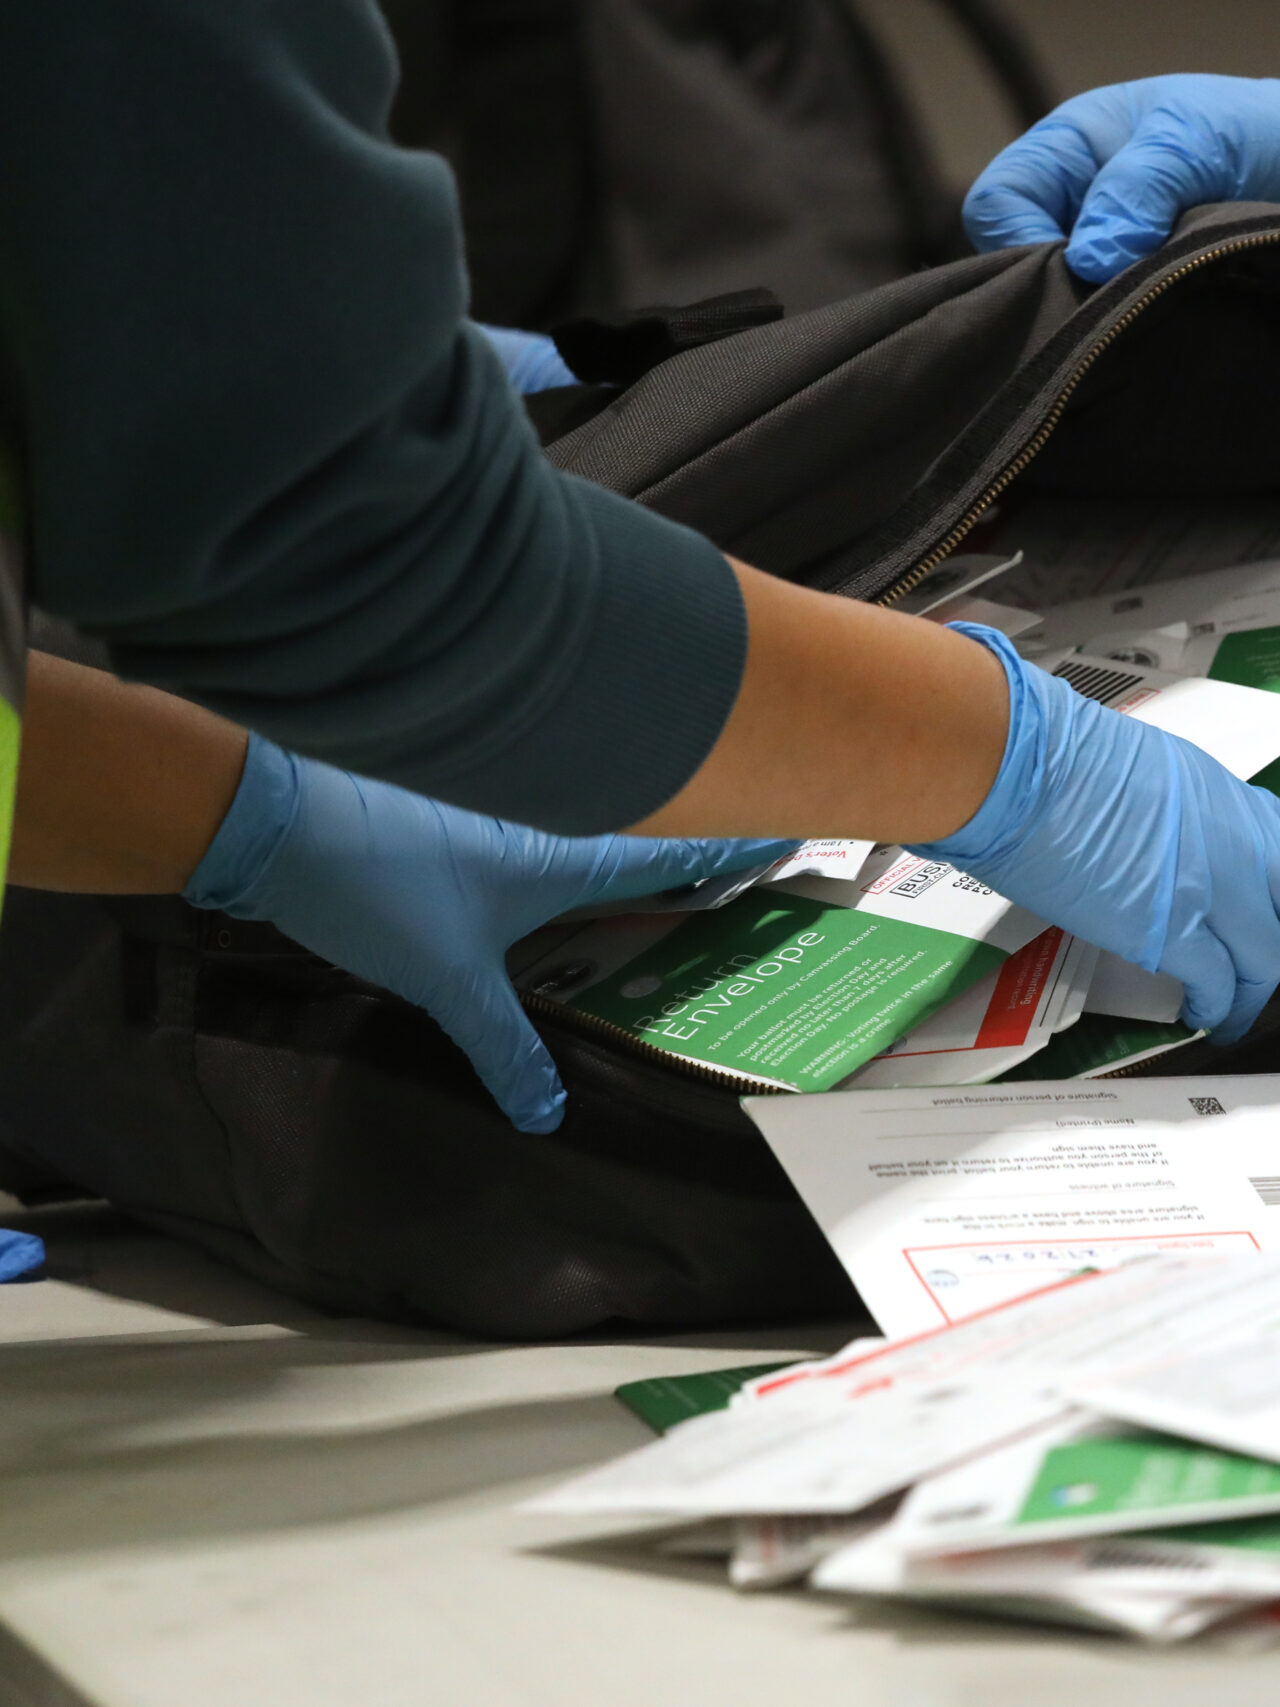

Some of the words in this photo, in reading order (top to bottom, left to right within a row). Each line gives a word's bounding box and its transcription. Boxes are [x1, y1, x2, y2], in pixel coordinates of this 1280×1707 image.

[806, 850, 846, 858] Voter's
[873, 864, 914, 889] OFFICIAL
[898, 862, 947, 892] BUSI
[913, 865, 955, 894] FIRST-CLA
[952, 876, 970, 888] CO
[661, 932, 825, 1040] Envelope
[708, 1041, 721, 1051] To
[719, 1031, 733, 1041] be
[734, 1005, 768, 1030] opened
[768, 990, 789, 1005] only
[787, 982, 801, 991] by
[800, 946, 852, 982] Canvassing
[848, 924, 881, 946] Board.
[632, 954, 758, 1033] Return
[737, 1042, 759, 1058] Your
[758, 1019, 786, 1040] ballot
[787, 1002, 810, 1020] must
[808, 994, 822, 1003] be
[822, 965, 862, 994] returned
[862, 958, 872, 967] or
[750, 1019, 801, 1062] postmarked
[800, 1010, 815, 1019] by
[813, 984, 851, 1010] Election
[850, 970, 870, 984] Day
[868, 958, 887, 971] and
[761, 1032, 798, 1064] received
[798, 1024, 811, 1032] no
[810, 1008, 832, 1023] later
[833, 992, 855, 1007] than
[863, 970, 885, 986] days
[884, 954, 906, 970] after
[771, 1038, 808, 1066] Election
[826, 1012, 842, 1022] No
[842, 985, 878, 1012] postage
[887, 950, 928, 979] required.
[801, 1038, 849, 1074] WARNING:
[847, 1016, 880, 1038] Voting
[877, 997, 902, 1017] twice
[901, 990, 913, 999] in
[911, 978, 928, 991] the
[928, 960, 952, 979] same
[813, 1049, 850, 1078] election
[865, 1017, 895, 1038] crime.
[964, 1096, 1013, 1104] returning
[1015, 1094, 1052, 1102] person
[1054, 1094, 1065, 1102] of
[1067, 1092, 1118, 1100] Signature
[932, 1098, 963, 1106] ballot
[1055, 1120, 1102, 1128] (Printed)
[1077, 1145, 1106, 1153] them
[1108, 1144, 1134, 1152] have
[1013, 1156, 1064, 1164] authorize
[1067, 1153, 1087, 1161] you
[1090, 1152, 1128, 1161] person
[868, 1163, 904, 1171] behalf
[907, 1160, 931, 1168] your
[933, 1160, 948, 1168] on
[1077, 1161, 1114, 1169] unable
[1137, 1159, 1157, 1167] you
[1000, 1165, 1022, 1173] your
[1026, 1164, 1060, 1172] return
[910, 1169, 929, 1177] the
[932, 1168, 957, 1177] print
[1068, 1183, 1108, 1191] witness
[1111, 1183, 1122, 1191] of
[1124, 1179, 1175, 1188] Signature
[1120, 1208, 1144, 1216] area
[1148, 1205, 1198, 1214] signature
[1084, 1210, 1117, 1218] above
[1113, 1217, 1149, 1225] unable
